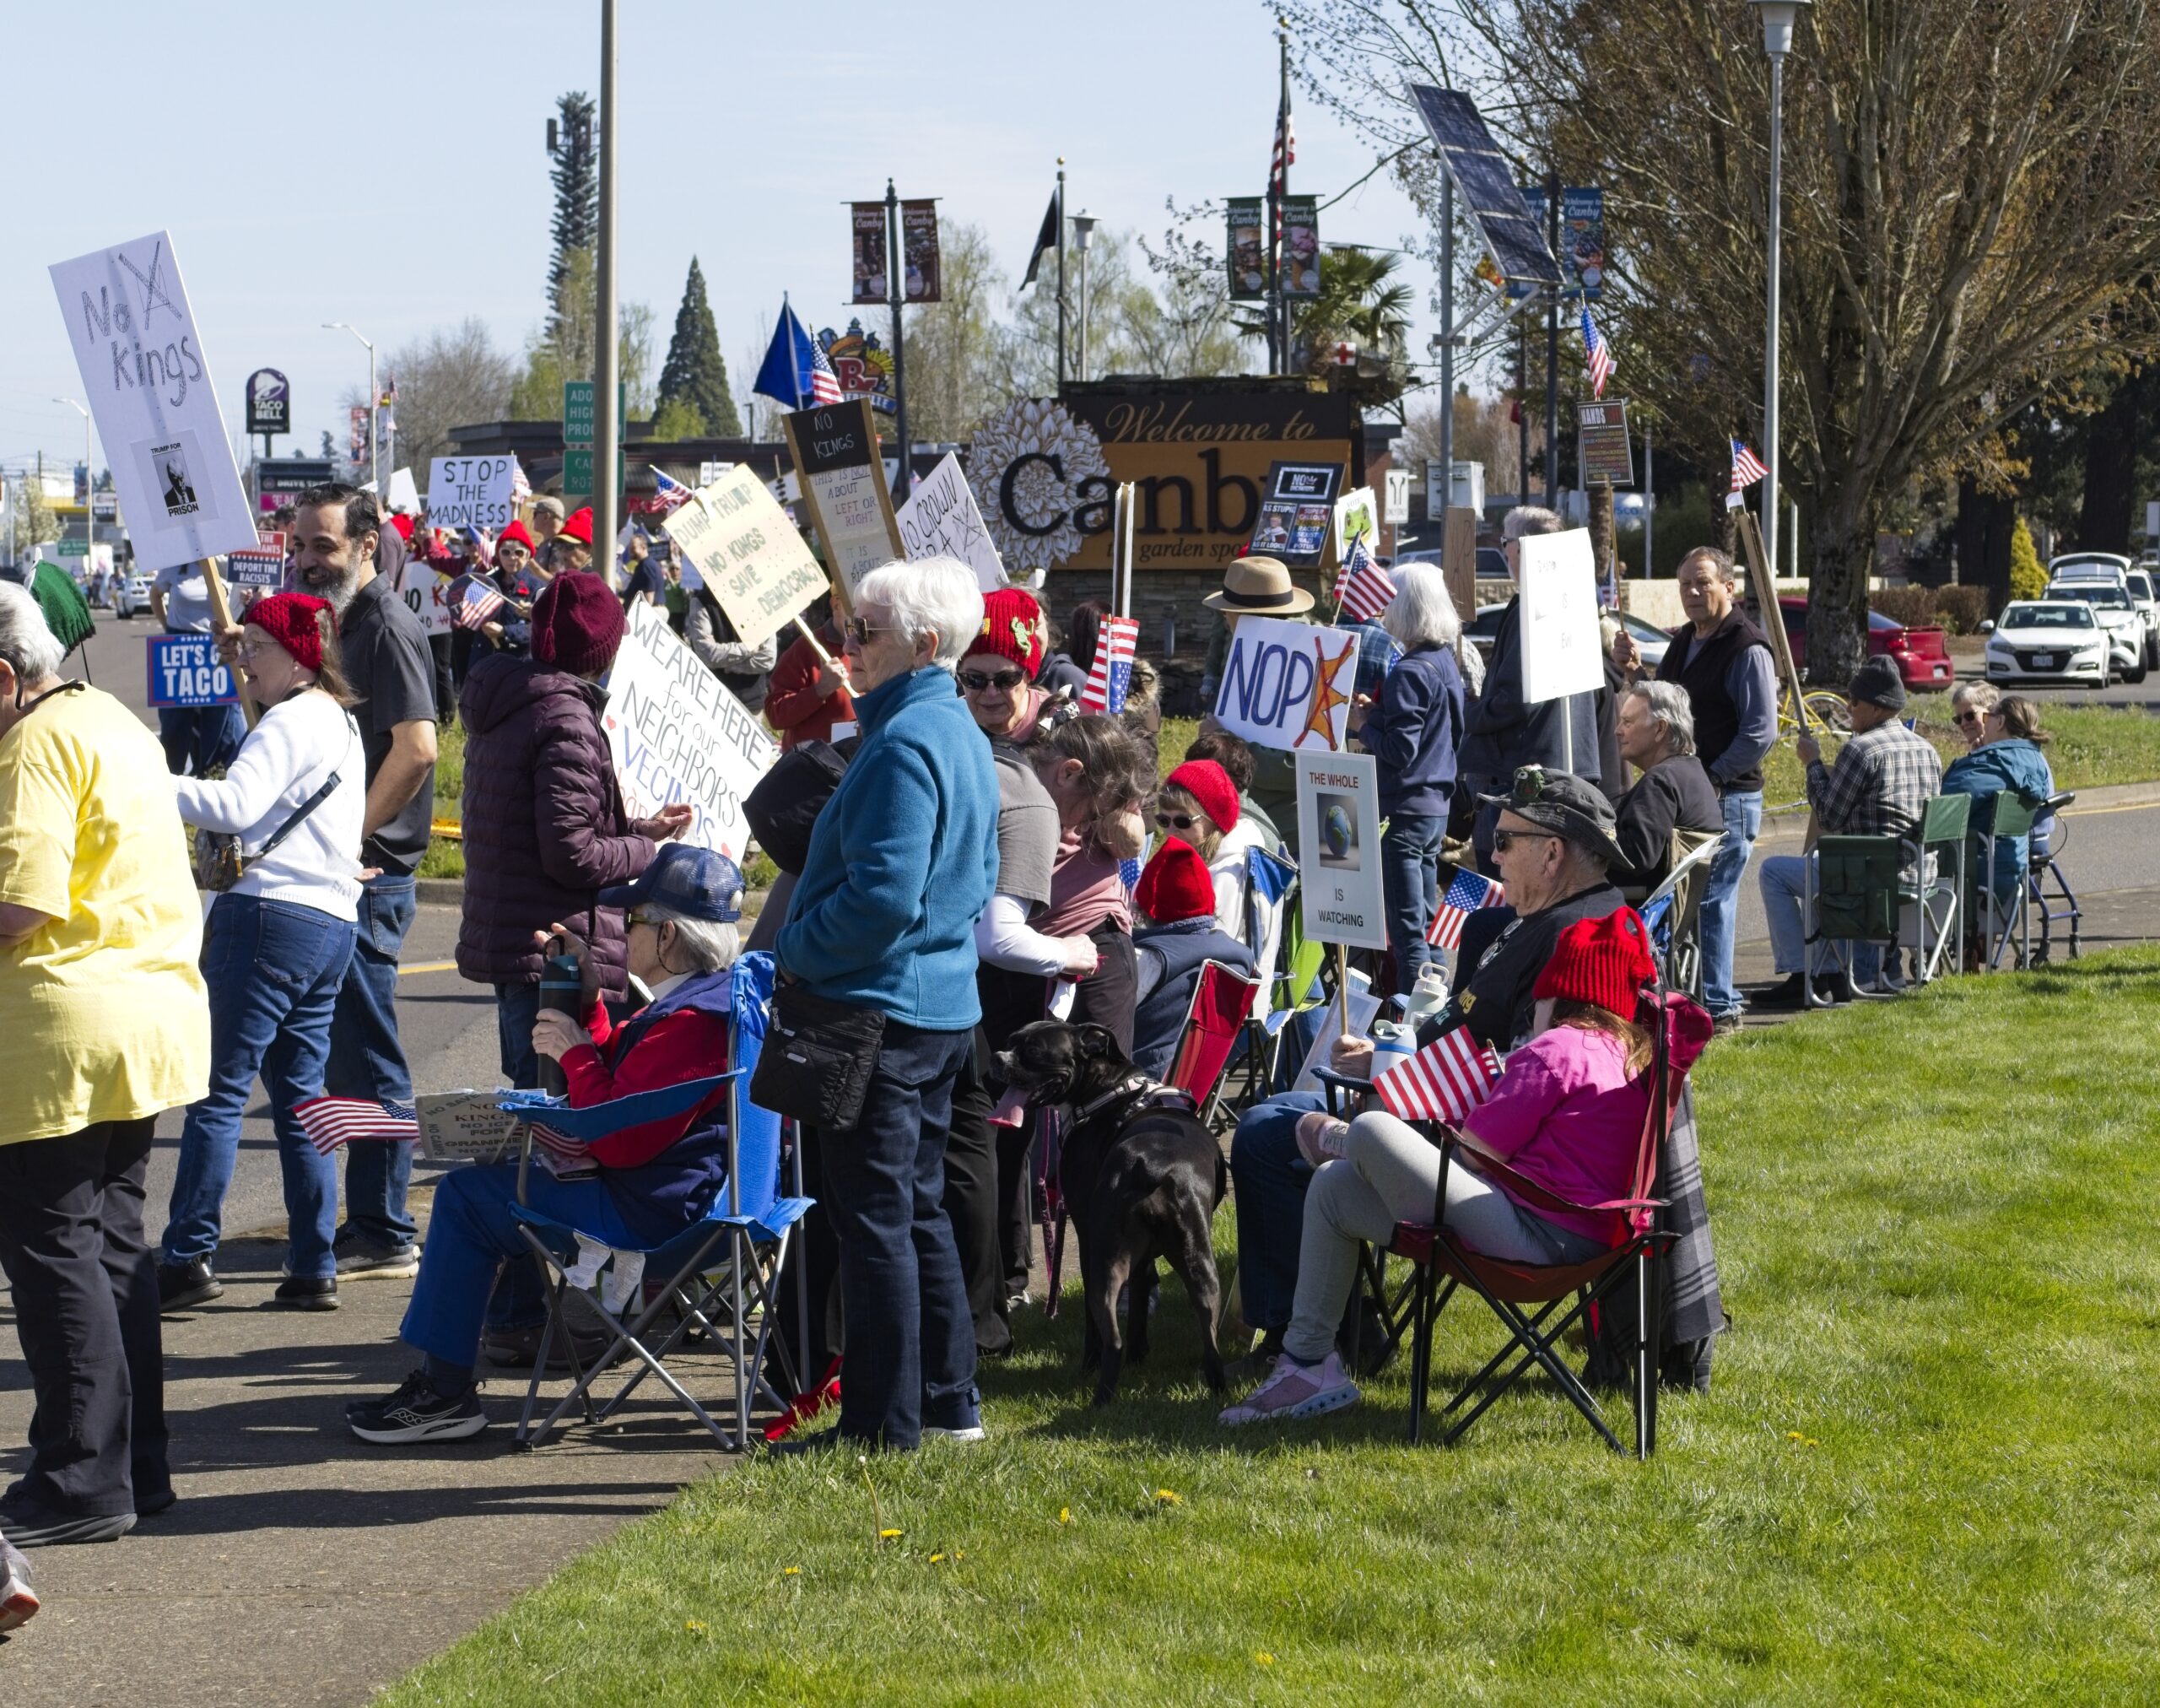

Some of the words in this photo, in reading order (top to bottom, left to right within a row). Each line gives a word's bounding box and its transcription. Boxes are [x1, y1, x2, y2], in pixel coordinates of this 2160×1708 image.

[905, 215, 934, 226] Canby
[1231, 214, 1259, 226] Canby
[1285, 212, 1315, 224] Canby
[1568, 207, 1600, 219] Canby
[856, 217, 883, 230] Canby
[570, 390, 594, 402] ADO
[254, 400, 284, 410] TACO
[256, 409, 283, 419] BELL
[814, 413, 833, 431] NO
[1106, 401, 1271, 443] Welcome
[1282, 410, 1317, 441] to
[1580, 408, 1606, 424] HANDS
[150, 446, 170, 454] TRUMP
[813, 433, 855, 459] KINGS
[444, 460, 507, 483] STOP
[814, 471, 834, 487] THIS
[839, 468, 848, 481] IS
[850, 464, 870, 479] NOT
[1291, 473, 1306, 486] NO
[456, 484, 487, 501] THE
[828, 482, 858, 499] ABOUT
[1000, 447, 1267, 537] Canb
[168, 503, 199, 516] PRISON
[835, 500, 858, 516] LEFT
[862, 495, 877, 509] OR
[917, 468, 958, 538] CROWN
[1272, 505, 1297, 514] STUPID
[427, 504, 506, 524] MADNESS
[845, 511, 874, 527] RIGHT
[674, 512, 711, 547] DUMP
[260, 534, 274, 543] THE
[705, 550, 728, 576] NO
[726, 527, 767, 562] KINGS
[858, 545, 868, 557] IS
[1139, 538, 1204, 561] garden
[1209, 543, 1242, 562] spo
[233, 562, 262, 573] DEPORT
[264, 564, 278, 574] THE
[239, 573, 271, 584] RACISTS
[728, 564, 763, 597] SAVE
[758, 559, 824, 616] DEMOCRACY
[161, 644, 205, 667] LET'S
[164, 666, 228, 698] TACO
[634, 600, 667, 665] WE
[665, 645, 713, 711] ARE
[711, 689, 765, 771] HERE
[663, 680, 693, 726] for
[692, 723, 721, 756] our
[622, 680, 742, 828] NEIGHBORS
[1310, 772, 1326, 786] THE
[1328, 774, 1358, 789] WHOLE
[1335, 888, 1344, 901] IS
[1318, 910, 1364, 927] WATCHING
[497, 1088, 520, 1097] NO
[425, 1106, 446, 1116] NO
[455, 1113, 517, 1122] KINGS
[428, 1123, 440, 1134] NO
[470, 1127, 505, 1136] FOR
